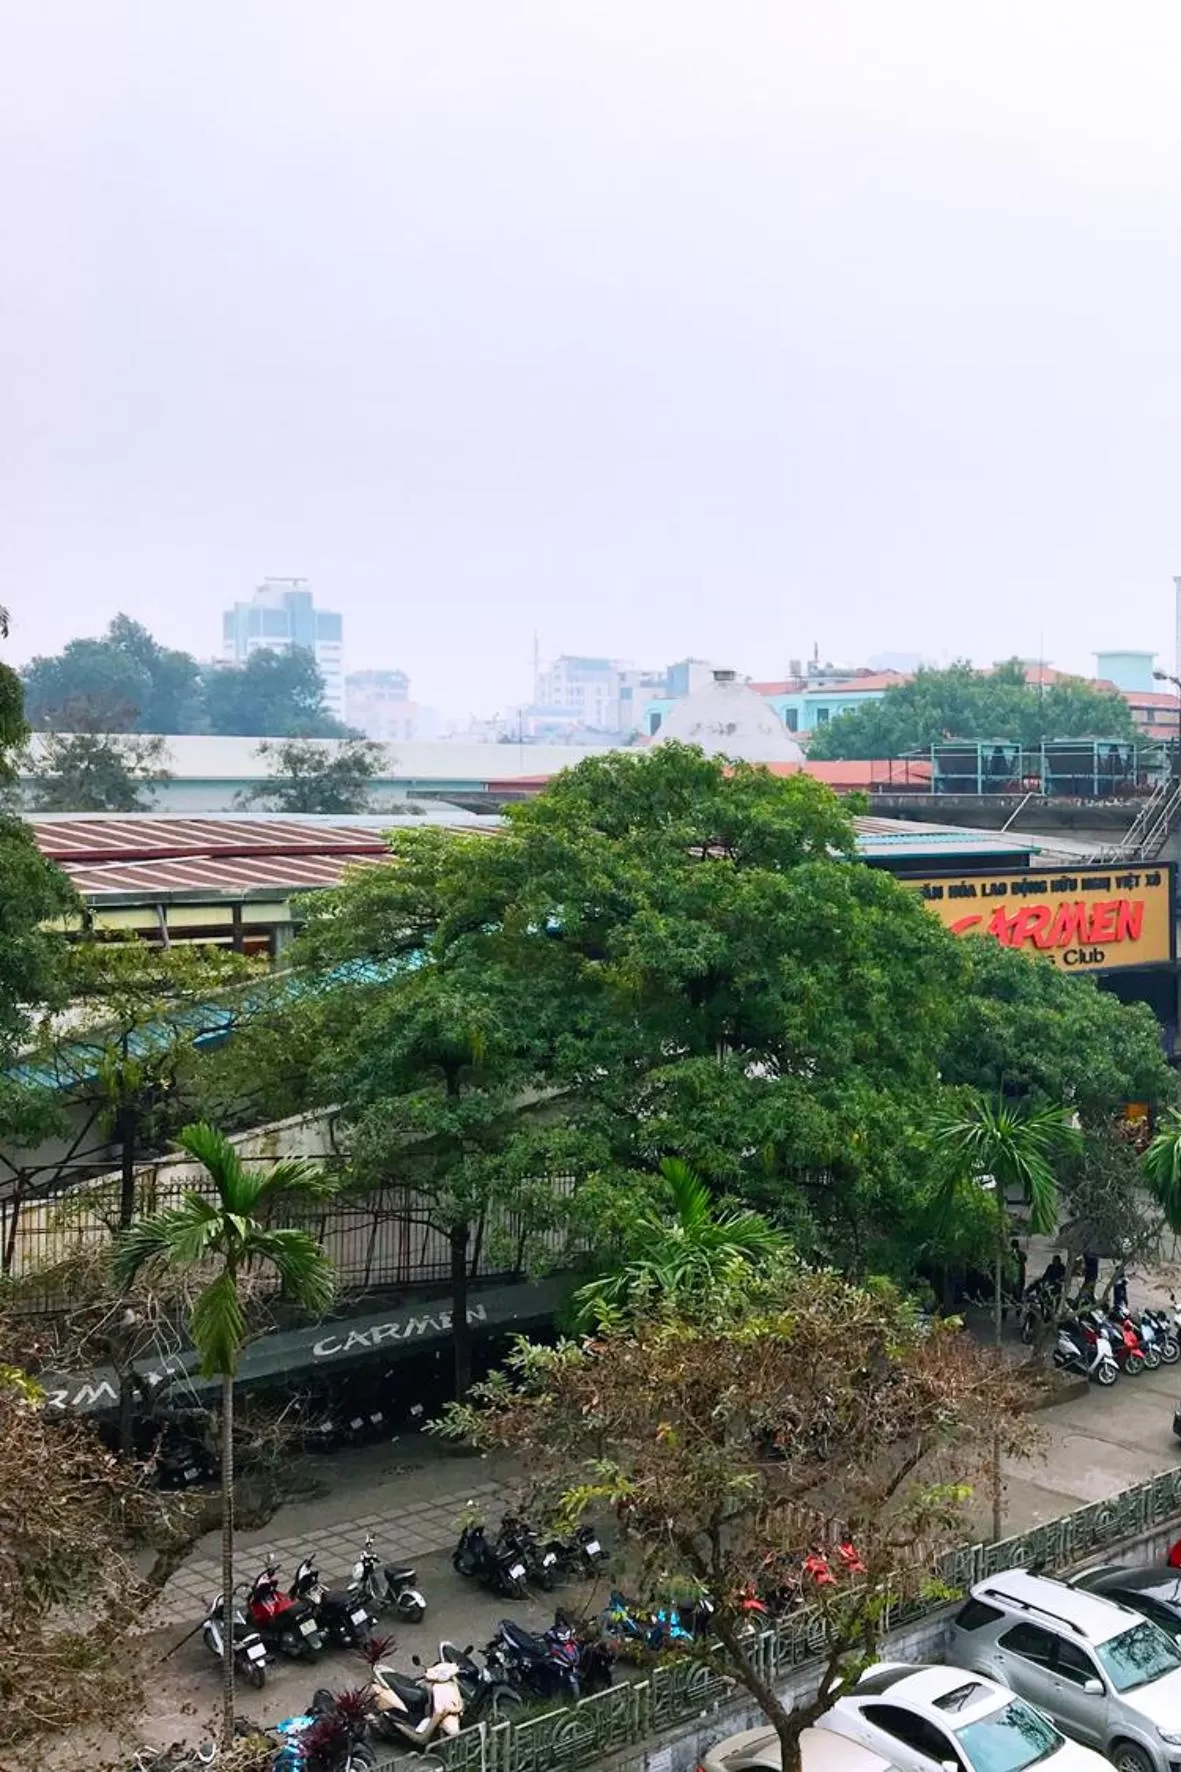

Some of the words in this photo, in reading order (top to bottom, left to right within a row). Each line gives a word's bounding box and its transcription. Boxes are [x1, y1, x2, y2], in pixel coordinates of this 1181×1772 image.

[919, 882, 944, 900] ĂN
[981, 882, 1008, 897] LAO
[1115, 872, 1141, 892] VIỆT
[1063, 947, 1105, 966] Club
